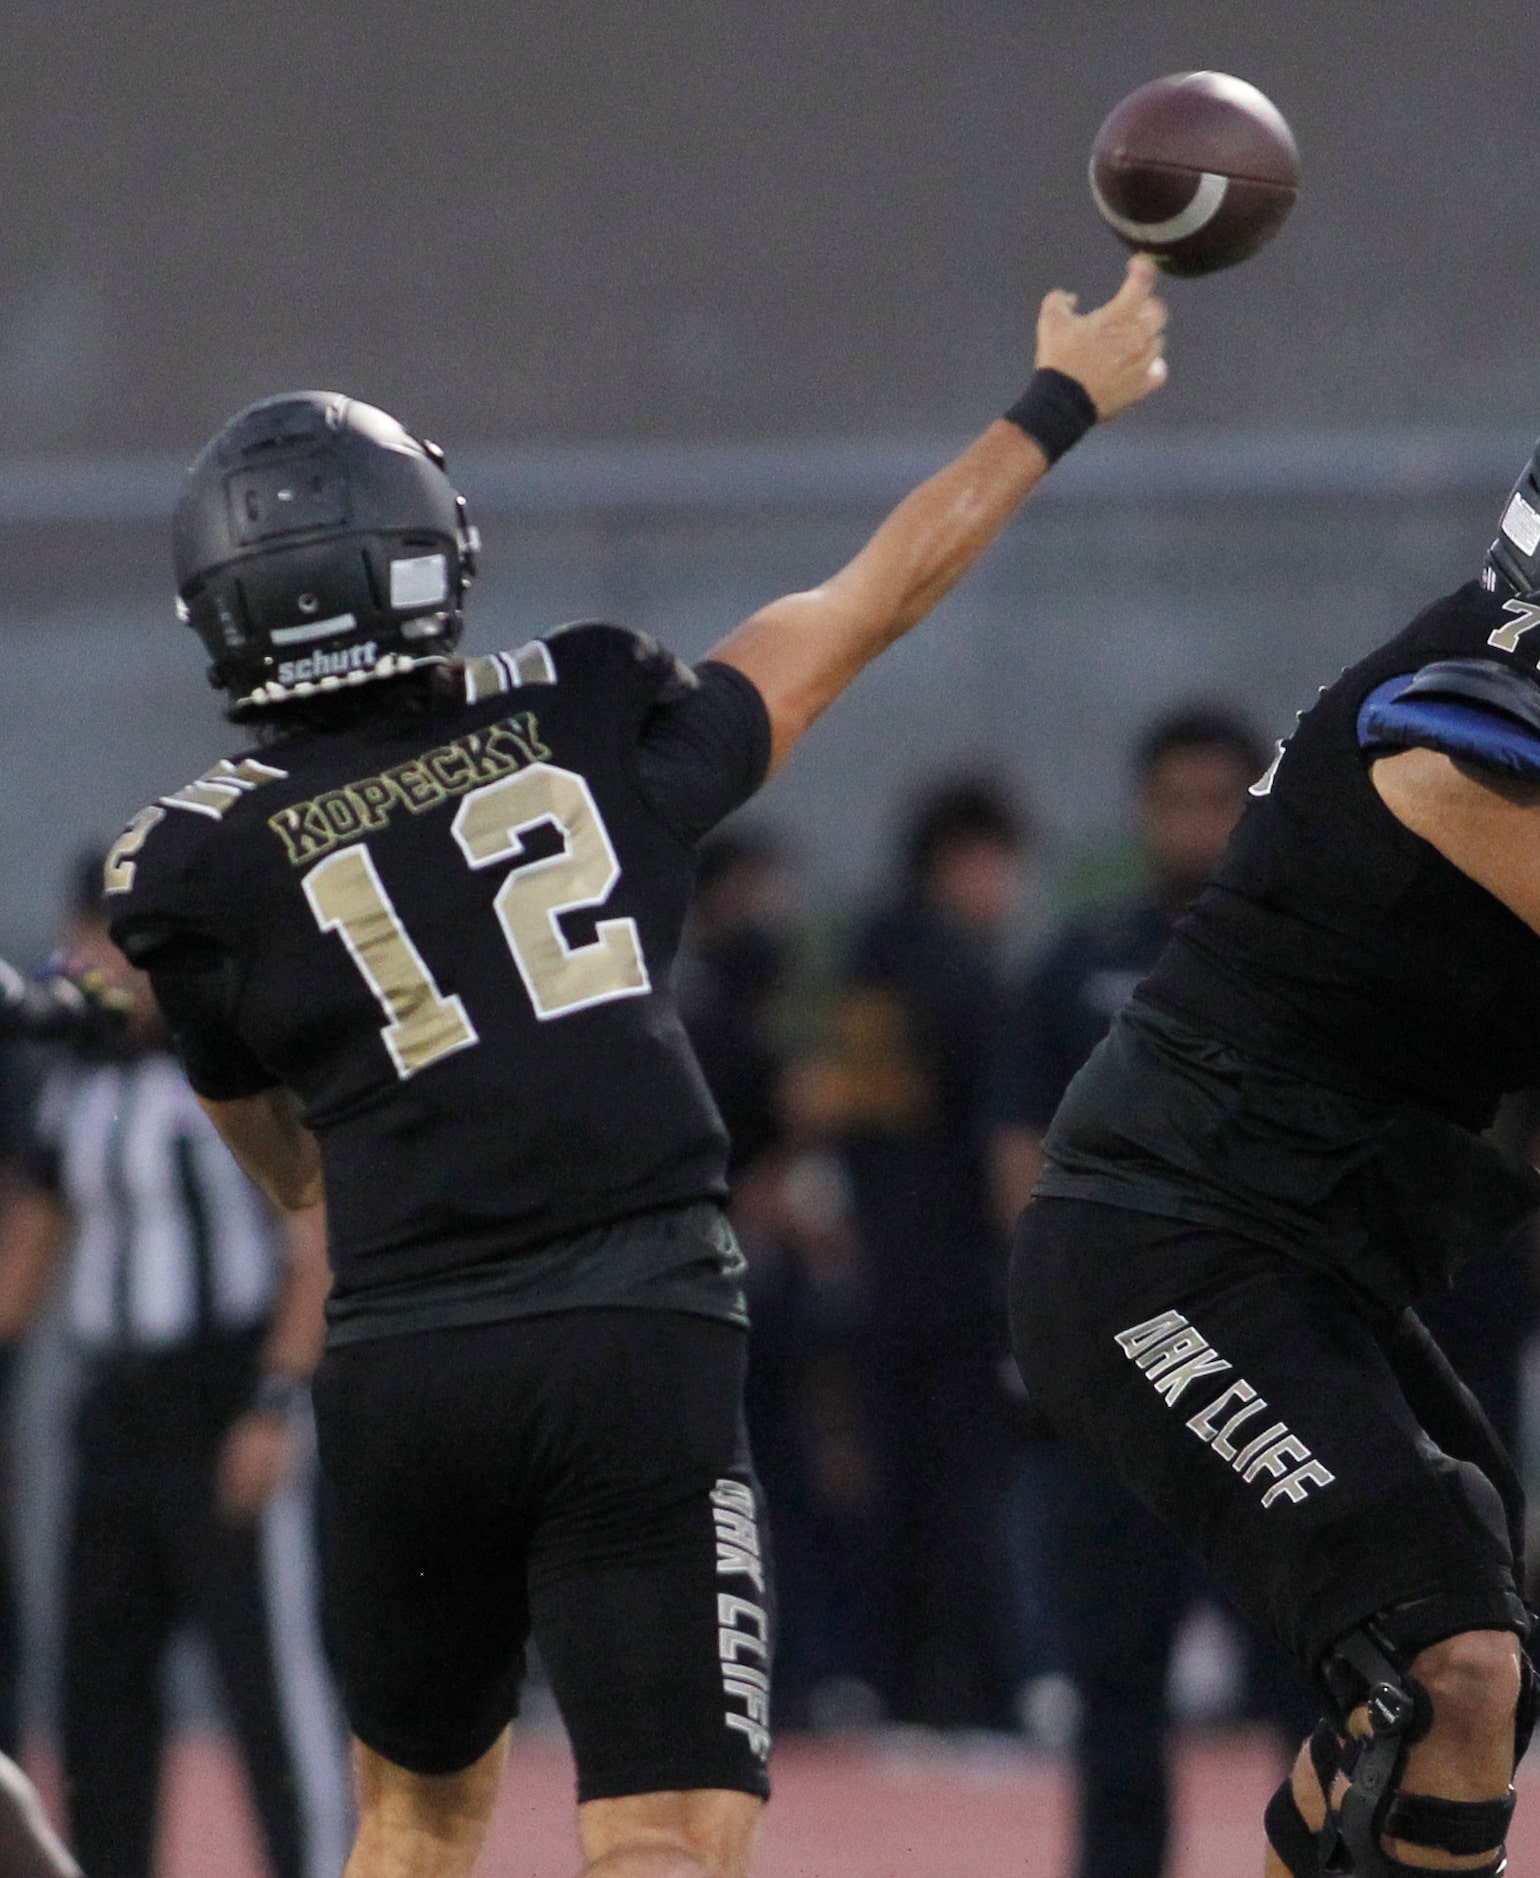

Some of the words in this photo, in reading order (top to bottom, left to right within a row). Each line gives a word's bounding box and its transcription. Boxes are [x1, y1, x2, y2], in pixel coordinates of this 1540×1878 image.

[277, 641, 378, 684] schutt
[268, 711, 552, 867] KOPECKY
[302, 761, 652, 1080] 12
[1114, 1309, 1232, 1407] OAK
[1185, 1378, 1335, 1508] CLIFF
